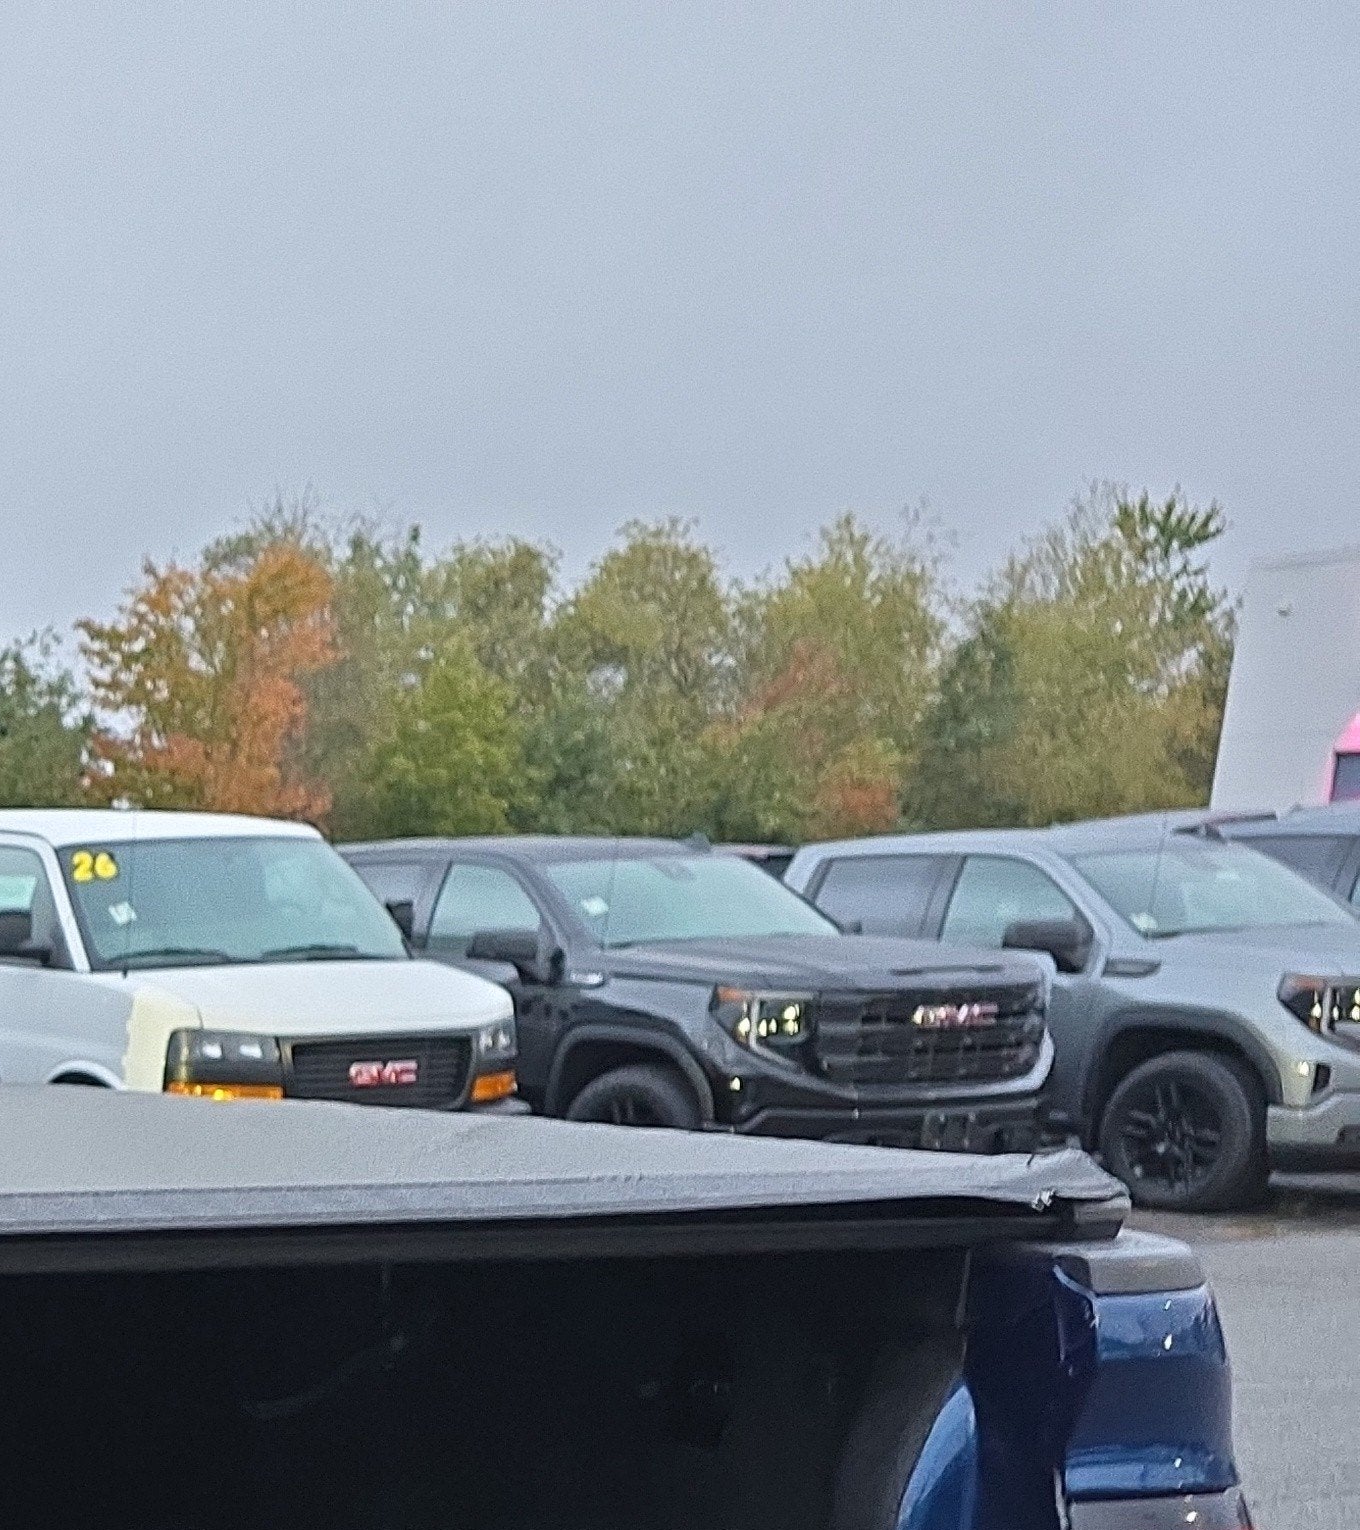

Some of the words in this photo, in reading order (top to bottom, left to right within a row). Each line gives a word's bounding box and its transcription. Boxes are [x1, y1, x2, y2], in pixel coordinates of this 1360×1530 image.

[72, 850, 117, 881] 26
[912, 1003, 999, 1028] GMC
[348, 1060, 418, 1086] GMC
